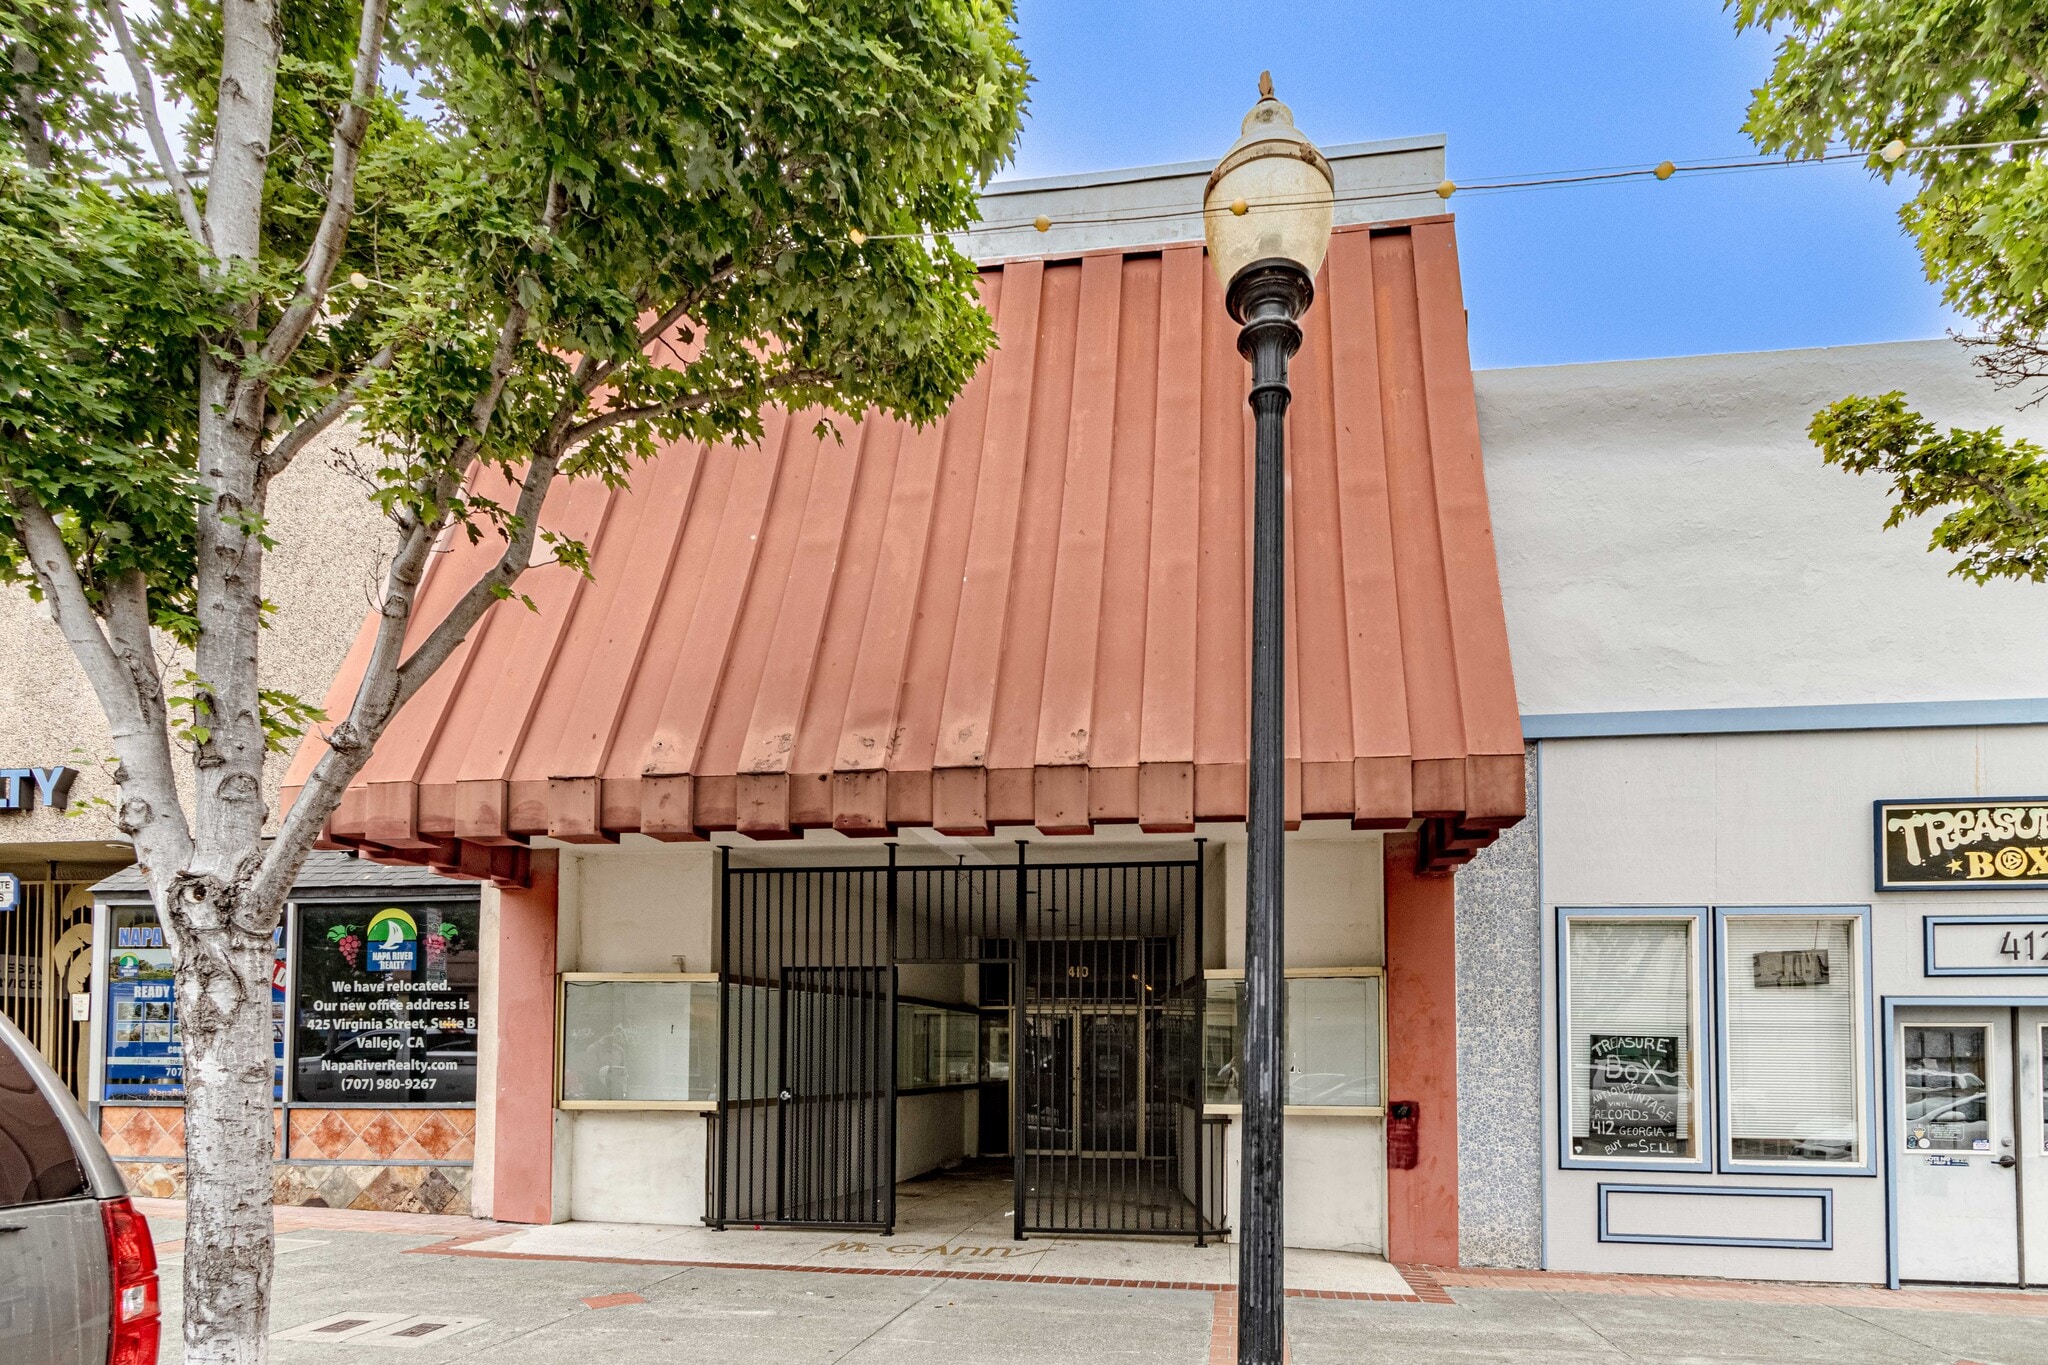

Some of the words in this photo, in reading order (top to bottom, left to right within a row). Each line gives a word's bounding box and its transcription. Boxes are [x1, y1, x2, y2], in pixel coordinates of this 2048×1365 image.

[118, 927, 163, 947] NAPA
[372, 951, 391, 961] NAPA
[392, 951, 414, 961] RIVER
[379, 960, 405, 970] REALTY
[1068, 966, 1089, 978] 410
[133, 985, 170, 998] READY
[332, 981, 352, 992] We
[353, 981, 384, 993] have
[386, 980, 451, 992] relocated.
[313, 1000, 337, 1012] Our
[339, 1002, 366, 1011] new
[368, 1000, 403, 1011] office
[405, 999, 457, 1010] address
[459, 998, 470, 1010] is
[307, 1019, 331, 1030] 425
[333, 1018, 383, 1033] Virginia
[385, 1018, 428, 1031] Street,
[430, 1018, 464, 1029] Suite
[467, 1018, 476, 1028] B
[356, 1037, 404, 1051] Vallejo,
[406, 1037, 425, 1048] CA
[1592, 1037, 1670, 1056] TREASURE
[321, 1059, 458, 1073] NapaRiverRealty.com
[341, 1078, 374, 1092] (707)
[376, 1078, 437, 1090] 980-9267
[1593, 1080, 1638, 1104] ANTIQUES
[1627, 1091, 1674, 1123] VINTAGE
[1594, 1109, 1649, 1121] RECORDS
[1592, 1120, 1616, 1135] 412
[1619, 1126, 1666, 1137] GEORGIA
[1604, 1139, 1623, 1155] BUY
[1639, 1139, 1674, 1154] SELL
